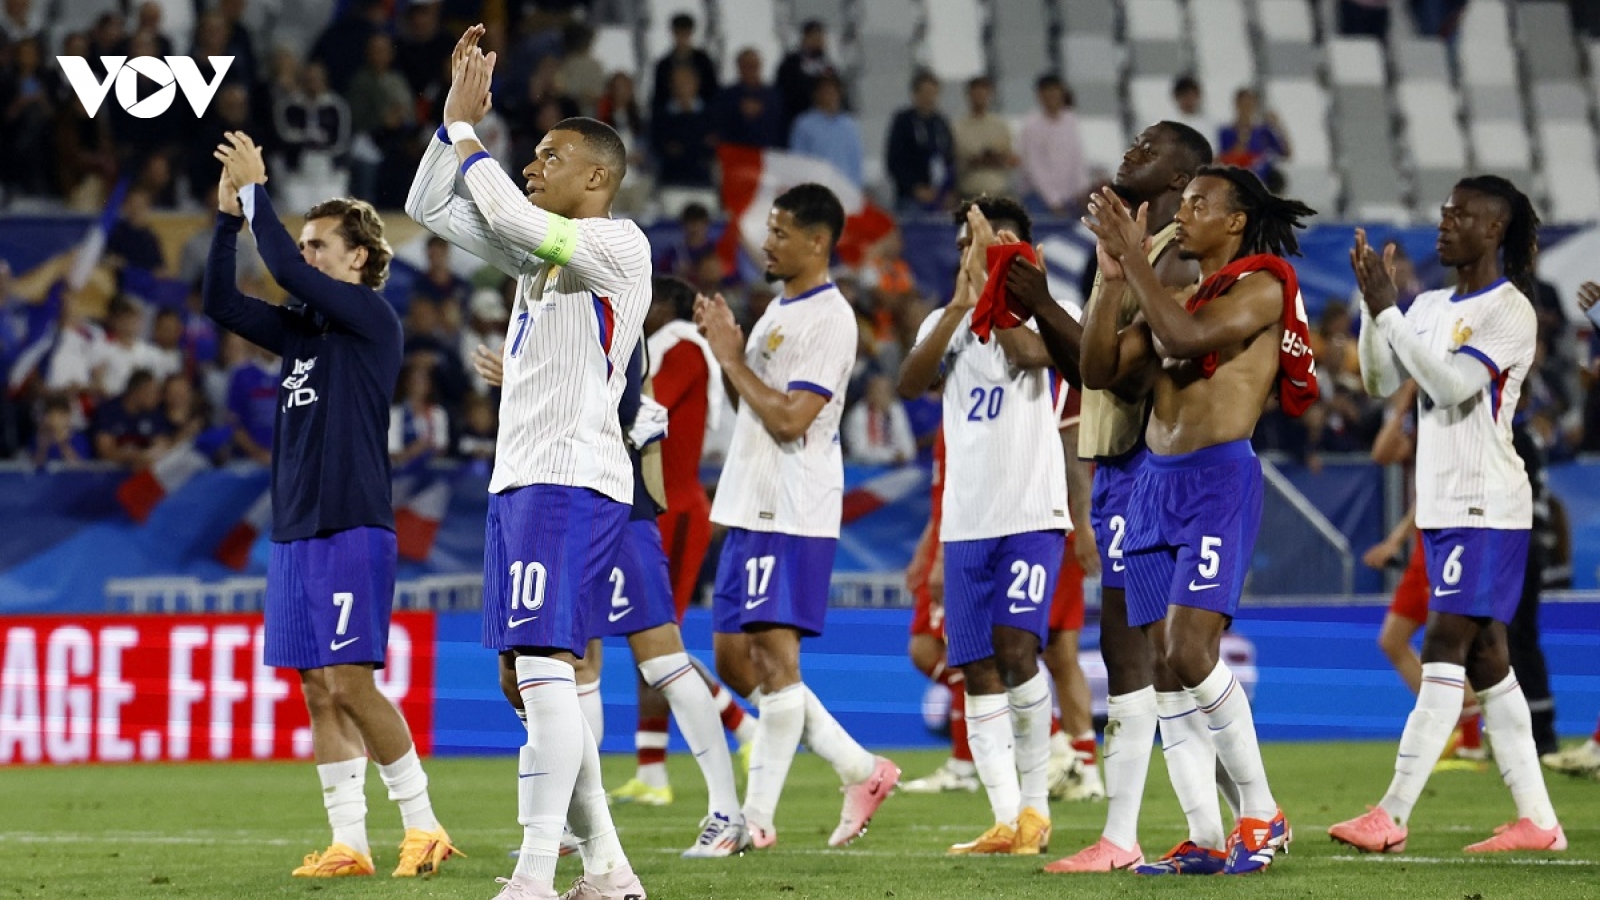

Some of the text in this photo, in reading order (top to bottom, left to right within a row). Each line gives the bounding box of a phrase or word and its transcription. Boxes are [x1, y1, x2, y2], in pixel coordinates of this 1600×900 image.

[967, 386, 1005, 421] 20
[745, 555, 776, 597] 17
[1198, 535, 1222, 579] 5
[1442, 544, 1465, 586] 6
[508, 560, 547, 611] 10
[608, 566, 630, 608] 2
[1007, 560, 1047, 604] 20
[332, 592, 354, 635] 7
